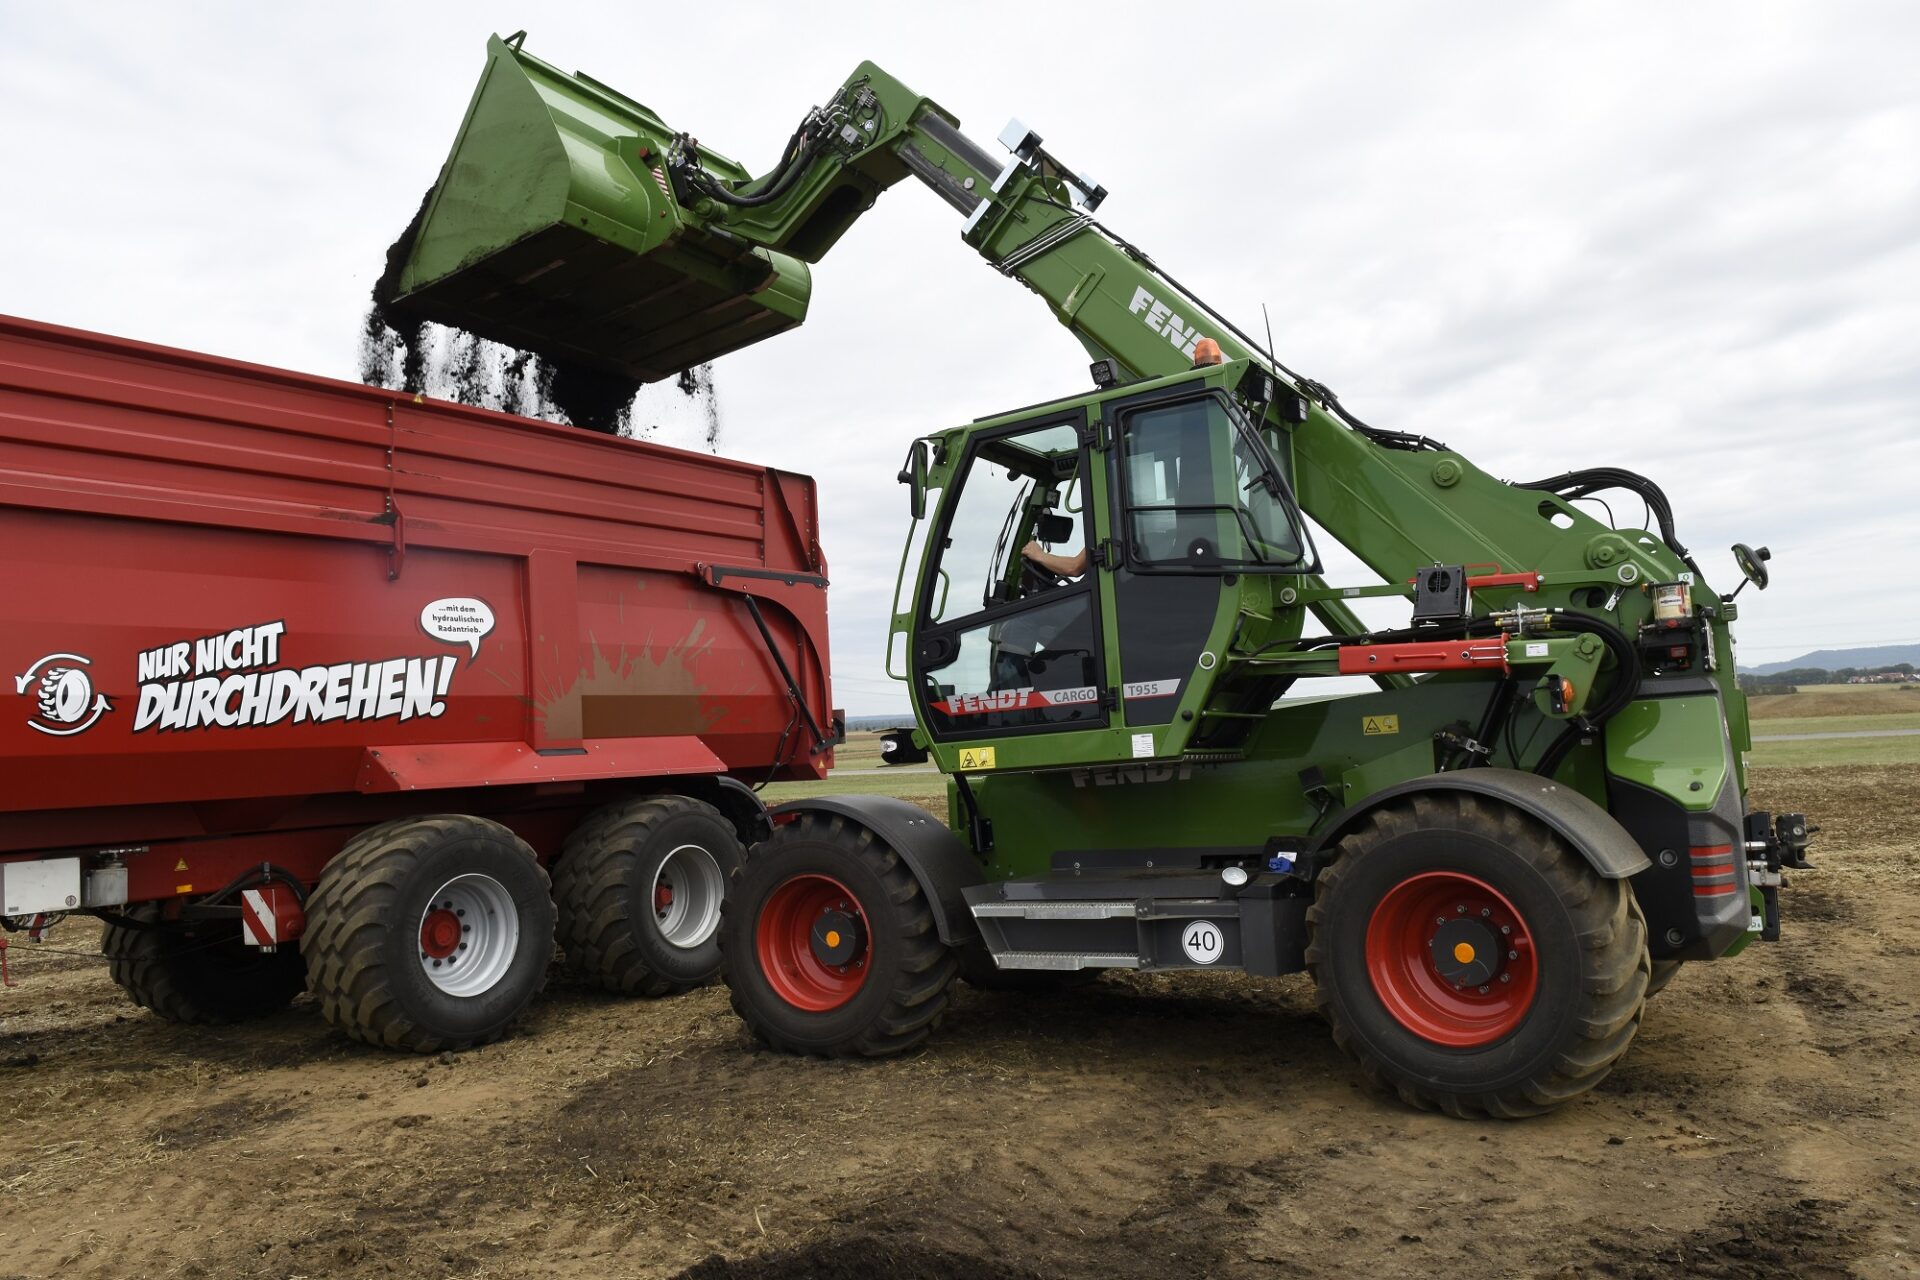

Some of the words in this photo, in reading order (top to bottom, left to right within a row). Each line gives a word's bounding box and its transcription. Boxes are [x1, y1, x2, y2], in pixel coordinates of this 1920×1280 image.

[1129, 285, 1233, 364] FEN
[432, 614, 484, 623] hydraulischen
[460, 605, 476, 613] dem
[438, 625, 481, 633] Radantrieb.
[138, 641, 191, 683] NUR
[195, 621, 284, 676] NICHT
[133, 655, 458, 731] DURCHDREHEN!
[946, 686, 1035, 714] FENDT
[1053, 688, 1096, 703] CARGO
[1128, 683, 1158, 697] T955
[1188, 931, 1216, 951] 40
